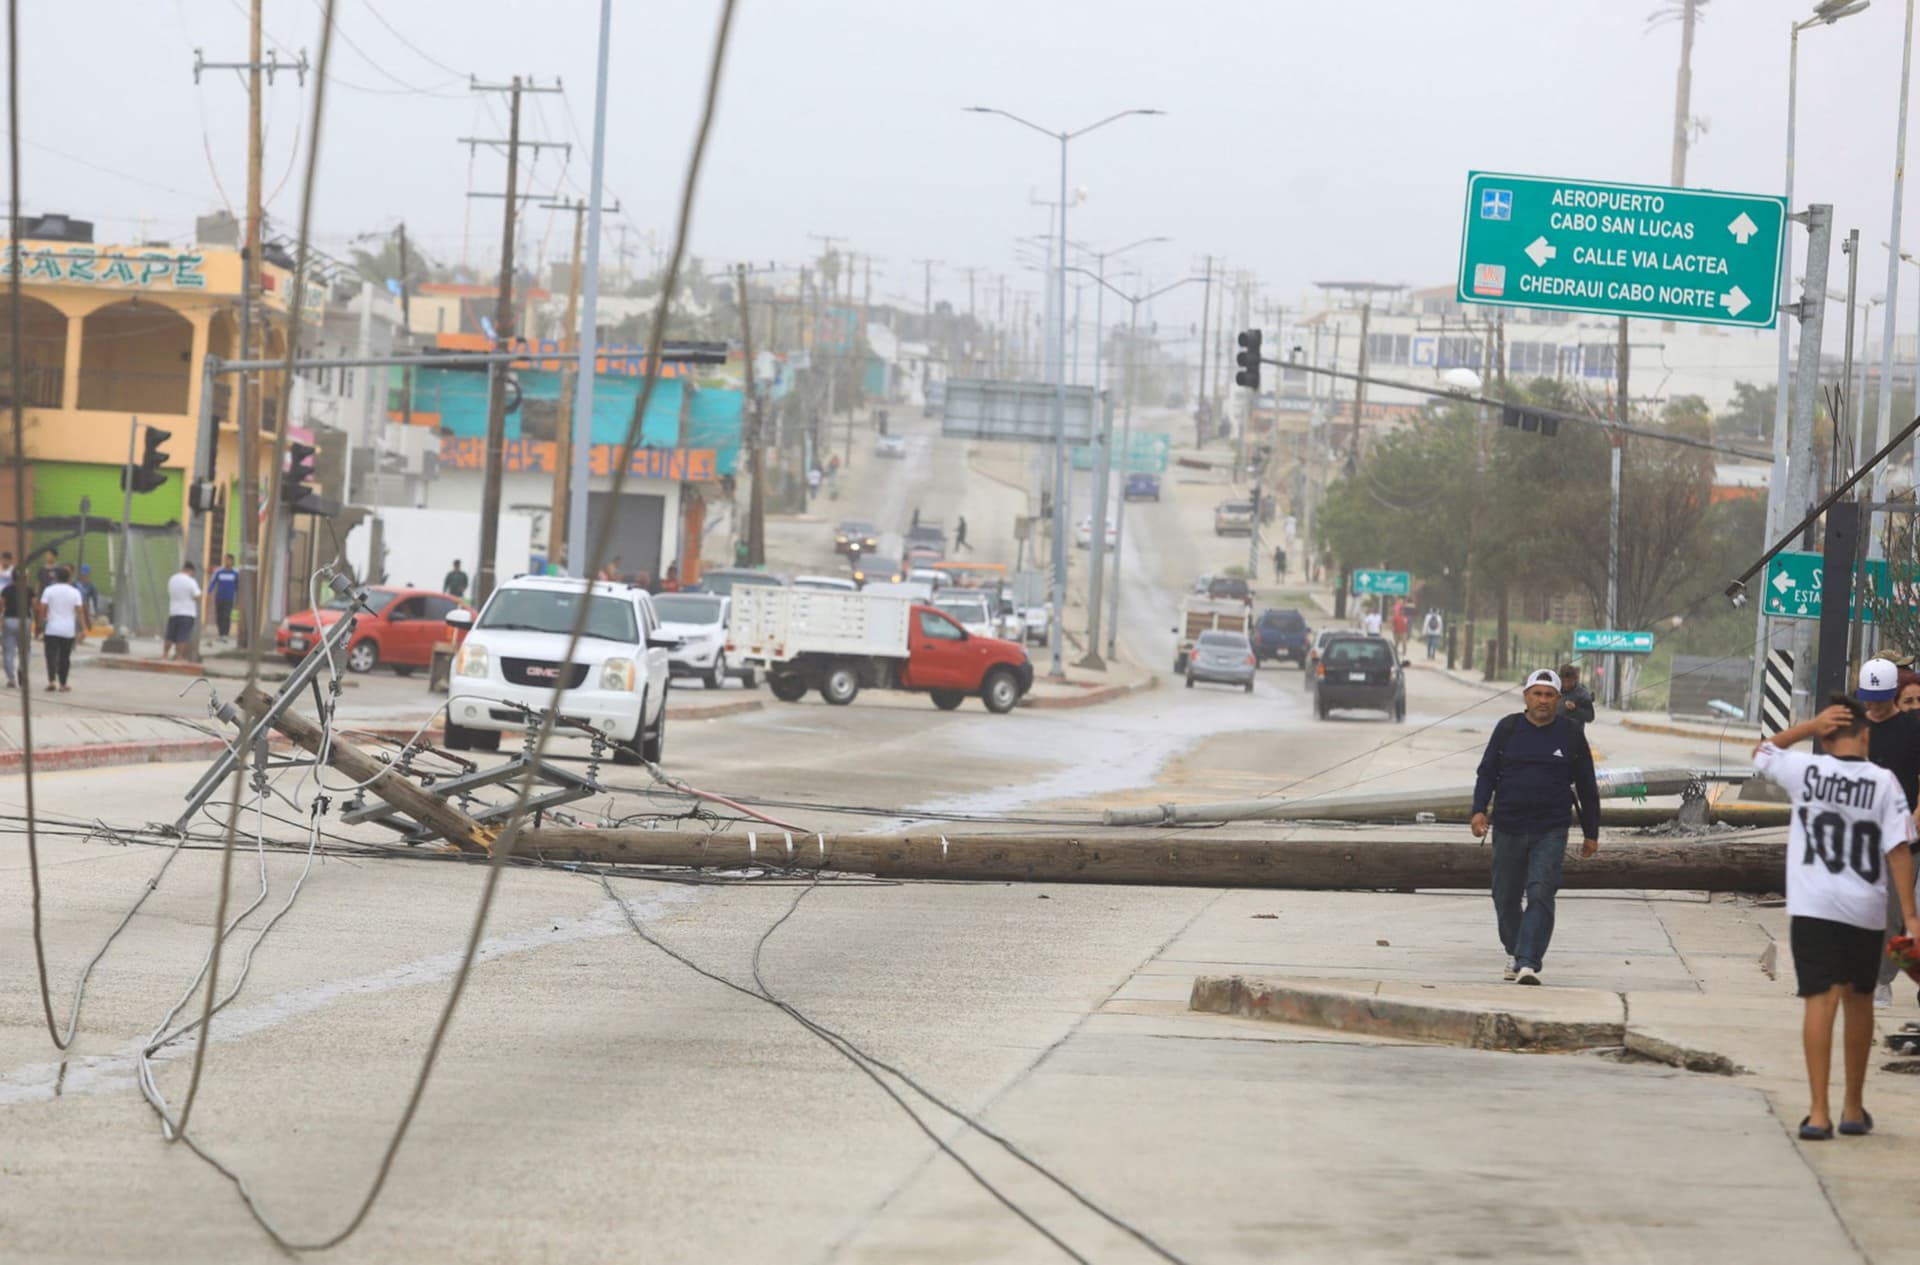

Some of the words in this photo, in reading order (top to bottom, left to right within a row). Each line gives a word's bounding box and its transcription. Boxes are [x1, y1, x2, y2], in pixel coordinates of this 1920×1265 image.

[1552, 189, 1664, 213] AEROPUERTO
[1551, 213, 1597, 231] CABO
[1601, 217, 1635, 235] SAN
[1639, 220, 1694, 240] LUCAS
[2, 243, 204, 286] SARAPE
[1573, 247, 1627, 267] CALLE
[1632, 250, 1658, 268] VIA
[1662, 253, 1728, 275] LACTEA
[1520, 274, 1603, 298] CHEDRAUI
[1607, 282, 1655, 302] CABO
[1659, 286, 1715, 308] NORTE
[1798, 806, 1882, 884] 100
